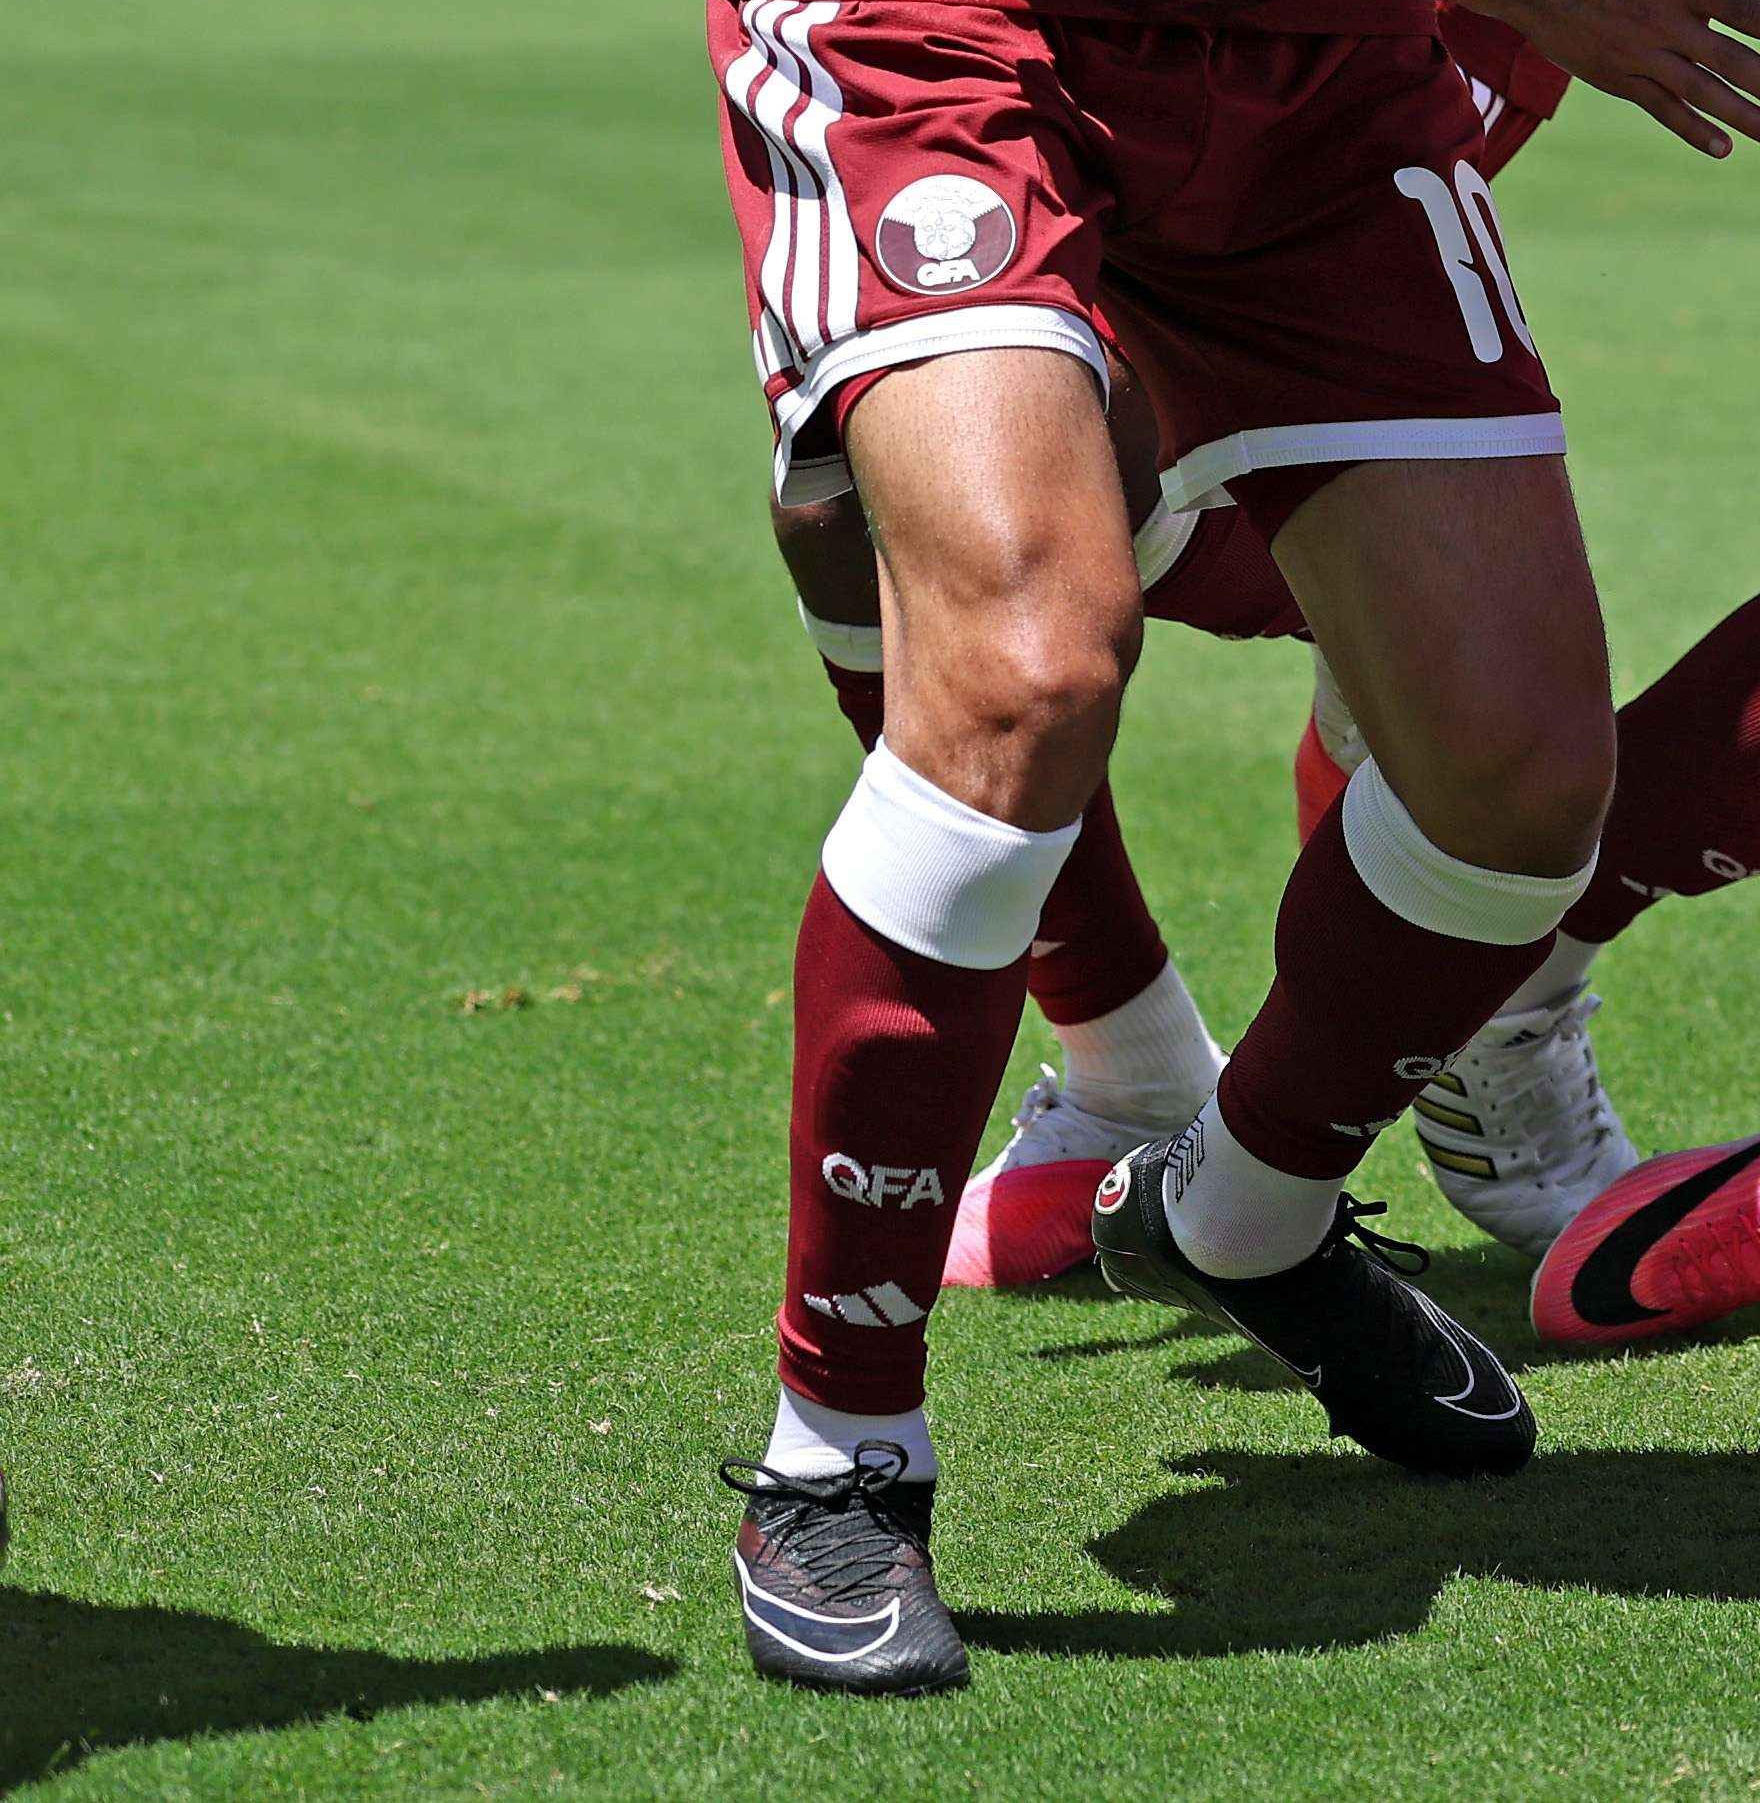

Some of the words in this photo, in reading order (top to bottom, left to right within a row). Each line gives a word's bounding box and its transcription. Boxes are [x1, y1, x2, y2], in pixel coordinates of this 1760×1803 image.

[916, 258, 982, 287] QFA
[1393, 159, 1537, 363] 10
[822, 1152, 944, 1210] QFA
